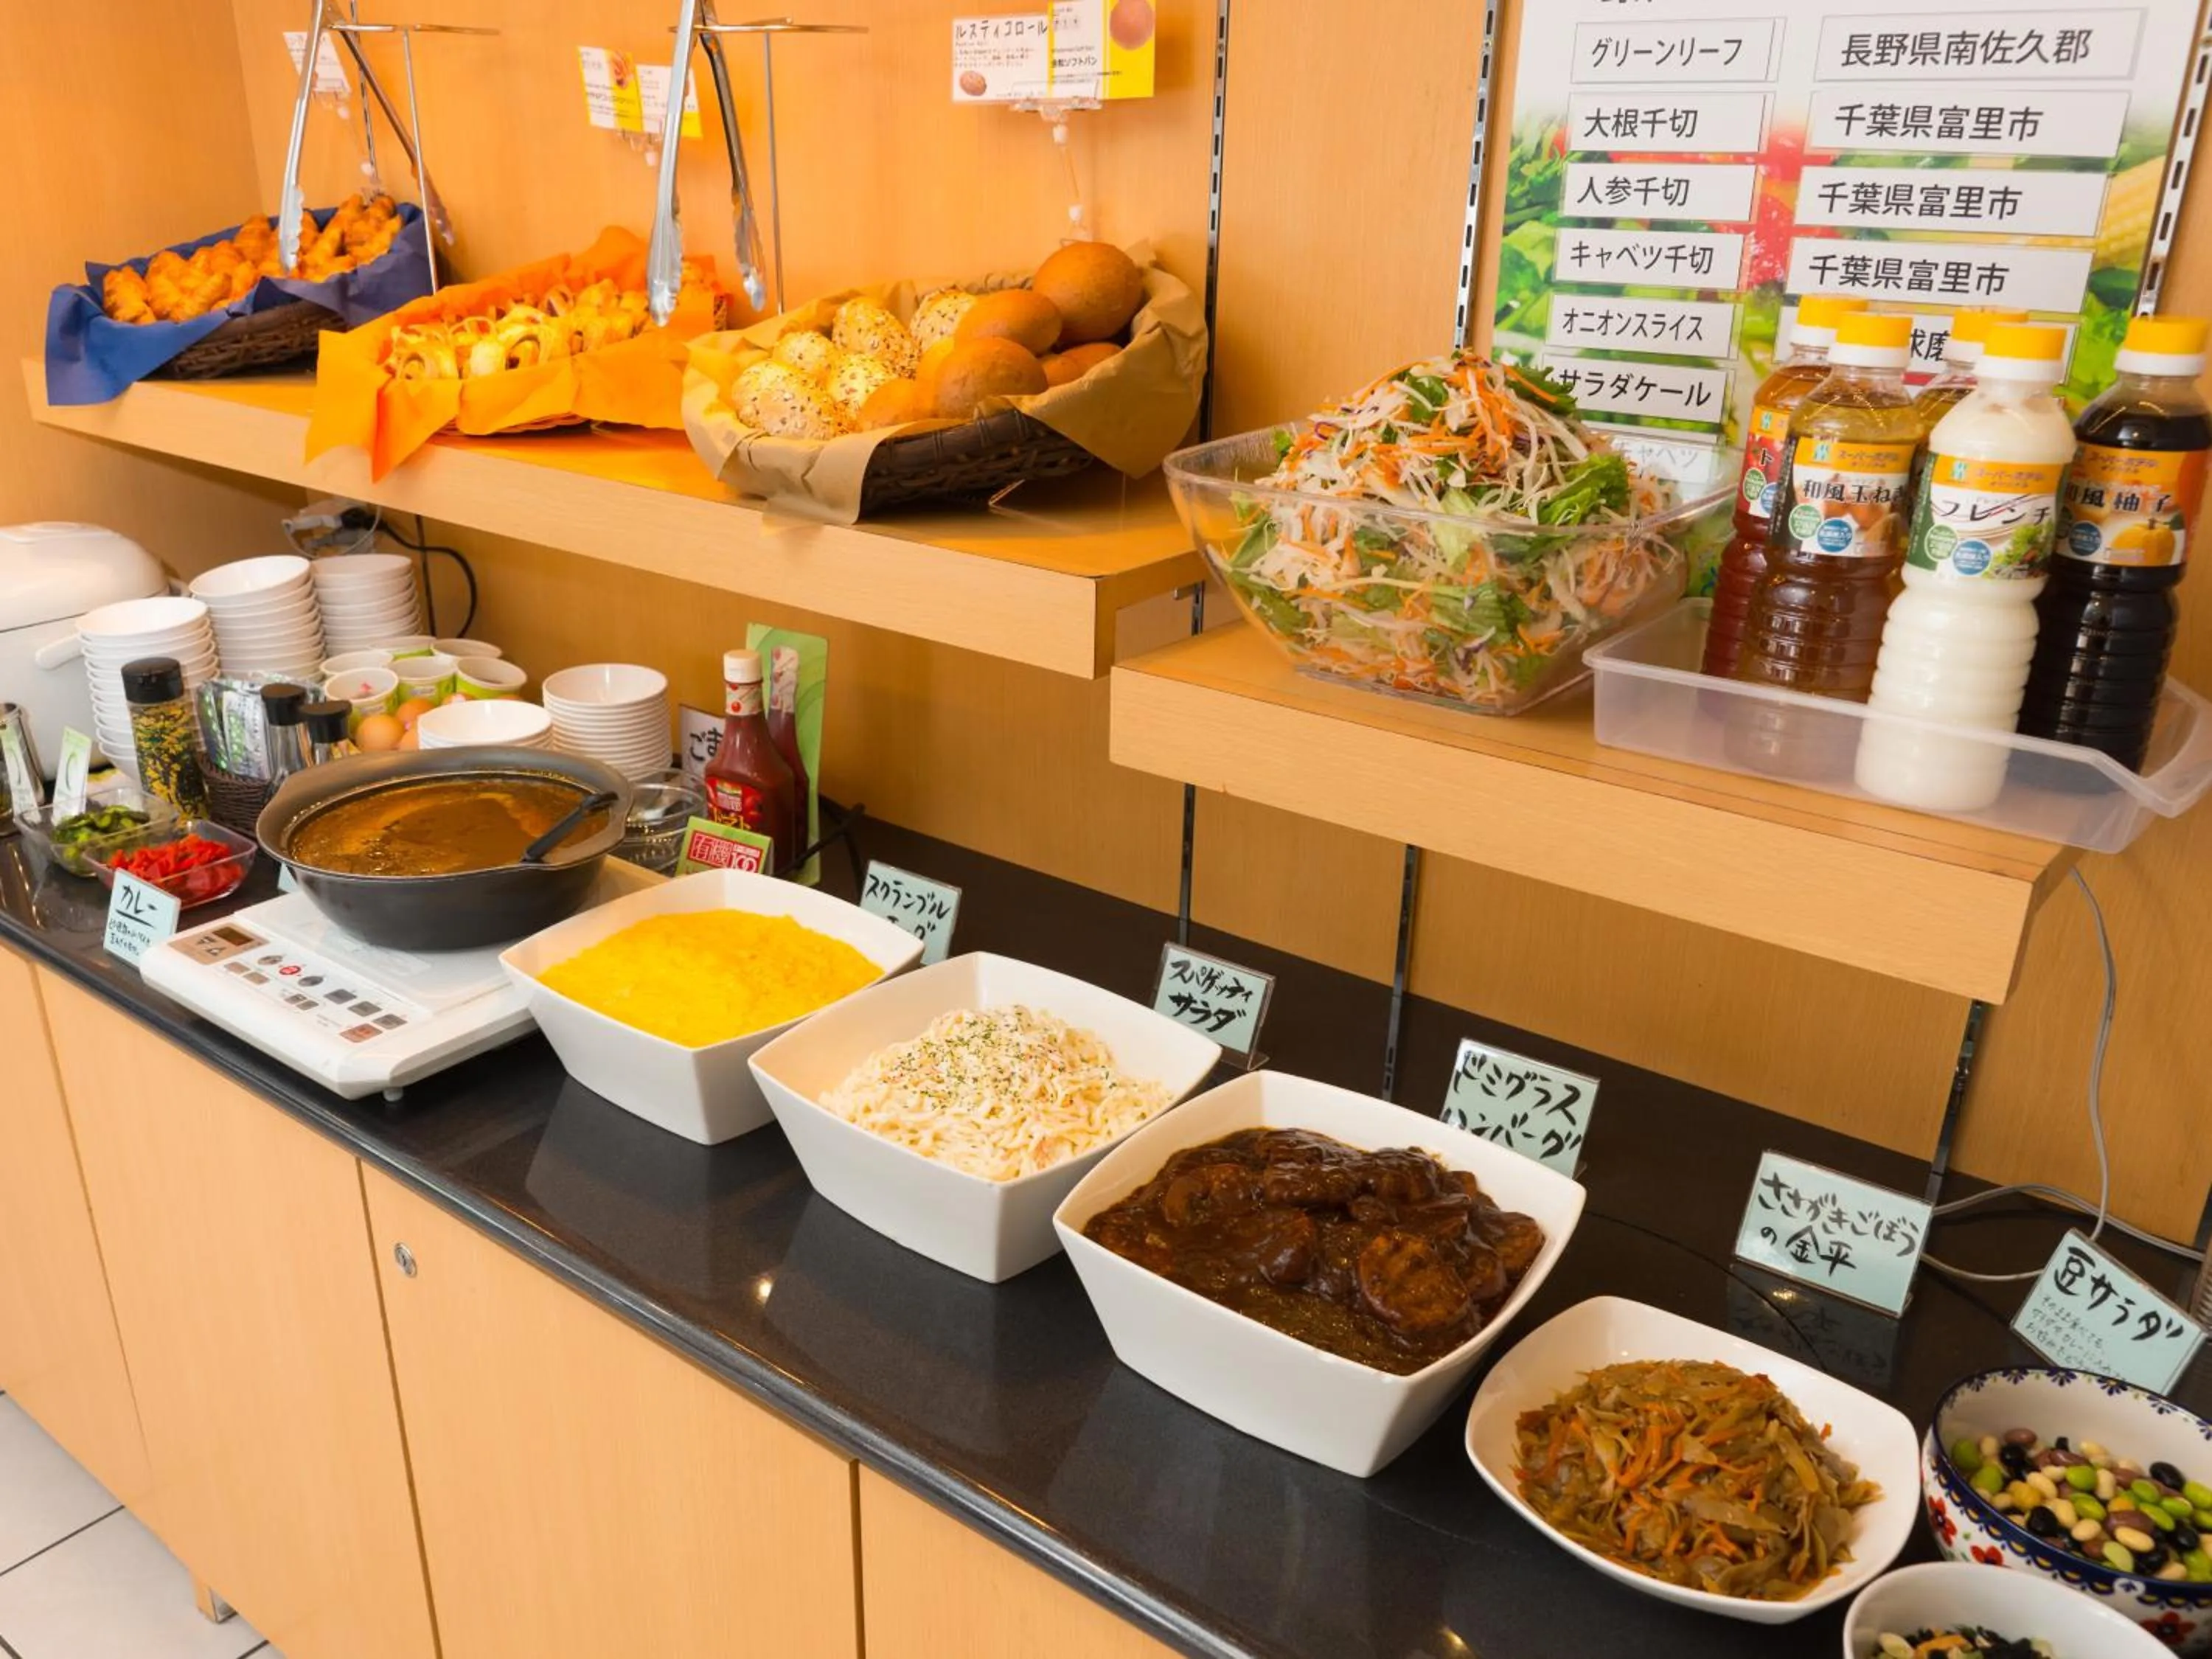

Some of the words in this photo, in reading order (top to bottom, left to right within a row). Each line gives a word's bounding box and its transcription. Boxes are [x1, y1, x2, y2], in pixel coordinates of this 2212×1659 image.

[1591, 37, 1743, 66] グリーンリーフ
[1841, 28, 2093, 67] 長野県南佐久郡
[1584, 108, 1698, 139] 大根千切
[1834, 103, 2043, 142] 千葉県富里市
[1577, 177, 1690, 206] 人参千切
[1818, 181, 2023, 220] 千葉県富里市
[1570, 242, 1714, 274] キャベツ千切
[1809, 254, 2009, 295] 千葉県富里市
[1562, 307, 1704, 341] オニオンスライス
[1559, 369, 1711, 406] サラダケール
[1940, 499, 2051, 526] フレンチ
[121, 884, 158, 915] カレー
[866, 874, 950, 919] スクランブル
[1169, 992, 1248, 1033] サラダ
[1453, 1049, 1582, 1127] ドミグラス
[1441, 1107, 1582, 1160] ハンバーグ
[1759, 1172, 1919, 1256] ささがきごぼう
[1760, 1225, 1857, 1277] の金平
[2053, 1243, 2185, 1345] 豆サラダ
